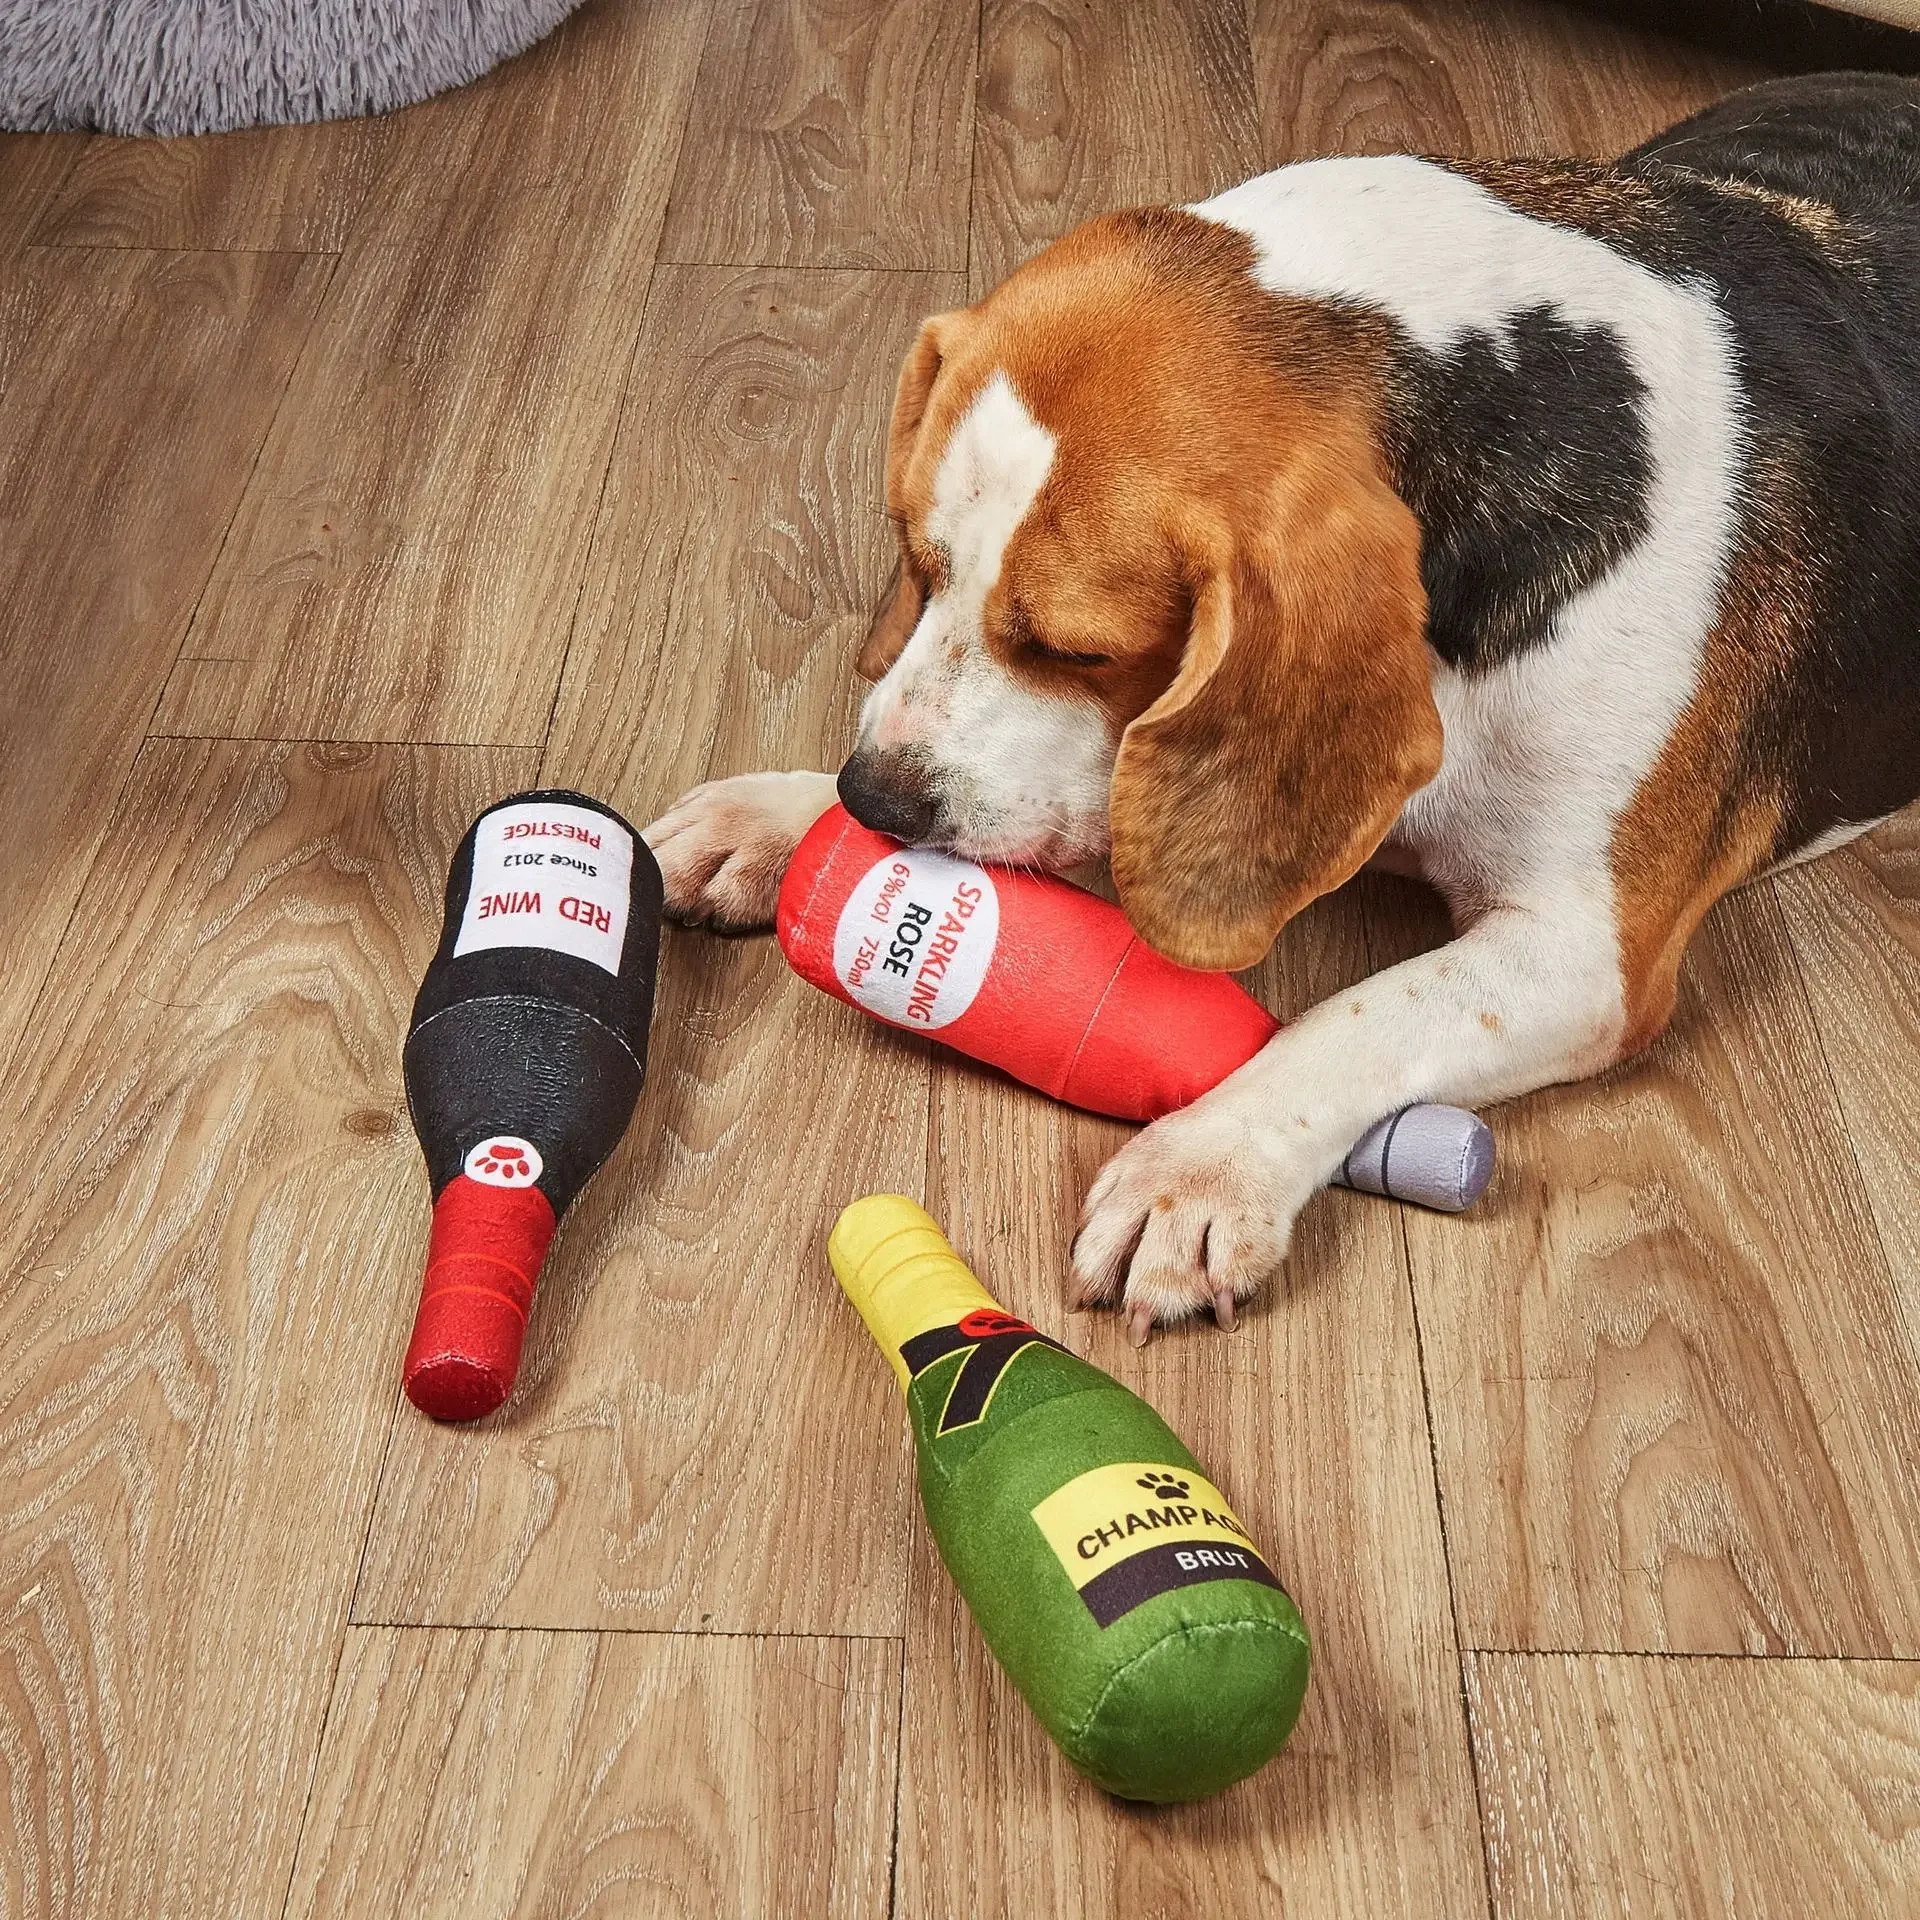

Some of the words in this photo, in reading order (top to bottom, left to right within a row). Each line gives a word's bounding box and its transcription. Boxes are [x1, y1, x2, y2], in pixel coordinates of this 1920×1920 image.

[503, 822, 601, 849] PRESTIGE
[503, 853, 545, 867] 2012
[550, 853, 598, 877] Since
[478, 892, 541, 919] WINE
[559, 896, 611, 933] RED
[882, 902, 933, 978] ROSE
[906, 881, 982, 1022] SPARKLING
[847, 936, 880, 988] 750ml
[1175, 1549, 1249, 1571] BRUT
